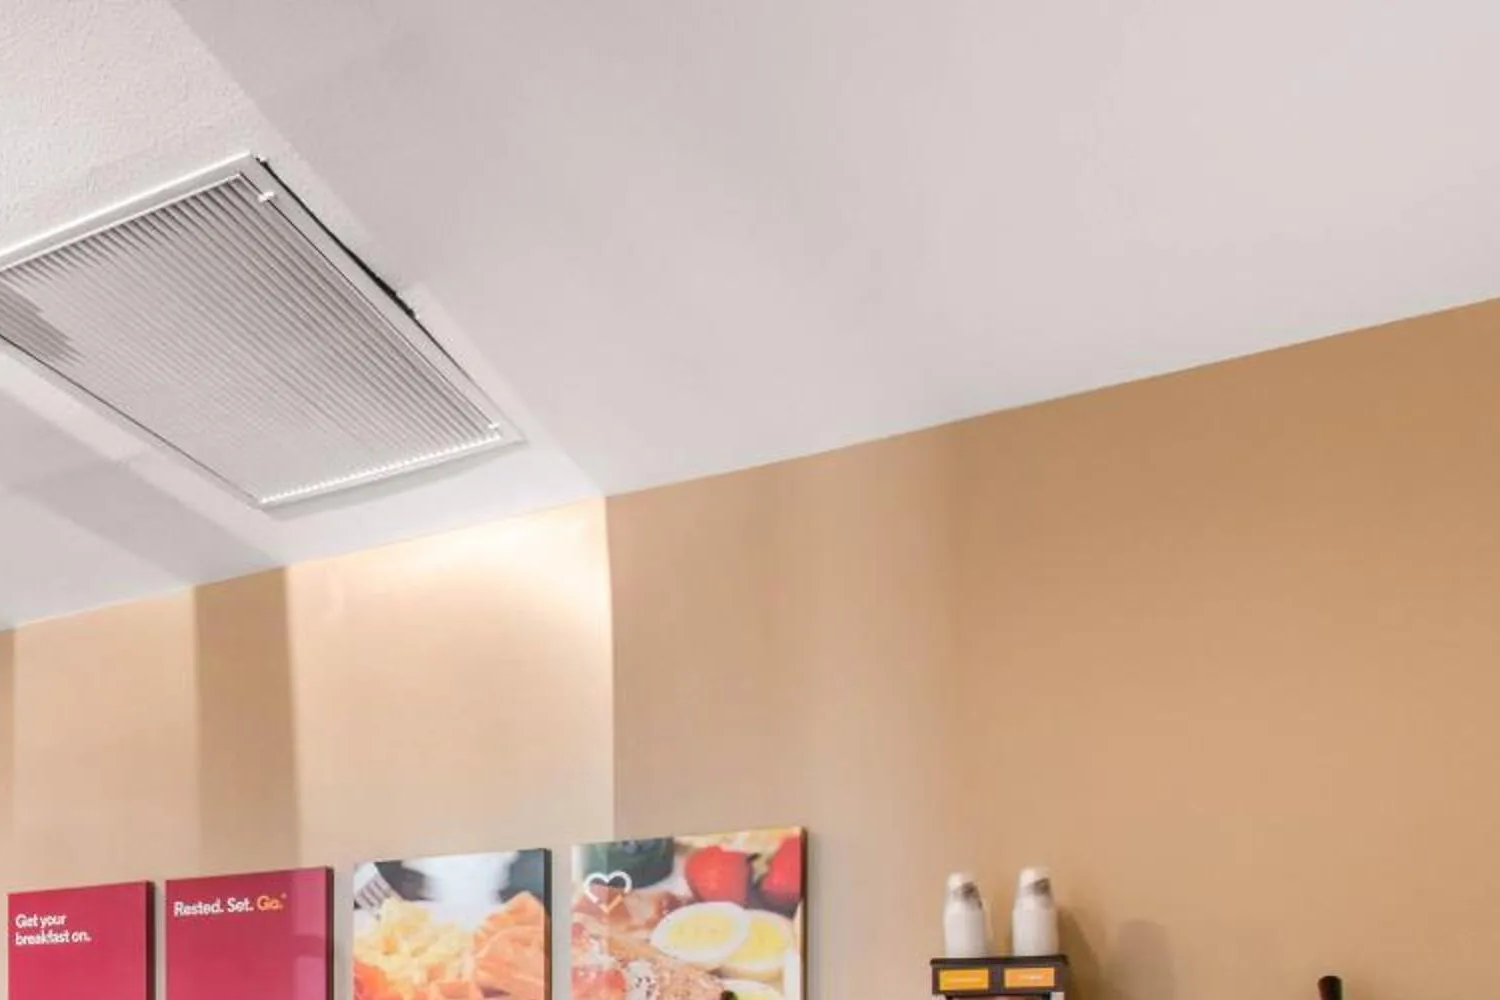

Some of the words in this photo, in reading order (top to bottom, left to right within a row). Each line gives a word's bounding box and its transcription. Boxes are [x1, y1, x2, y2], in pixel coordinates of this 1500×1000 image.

[173, 897, 225, 917] Rested.
[227, 896, 255, 913] Set.
[15, 913, 38, 929] Get
[39, 913, 68, 929] your
[15, 929, 70, 946] breakfast
[71, 930, 92, 943] on.
